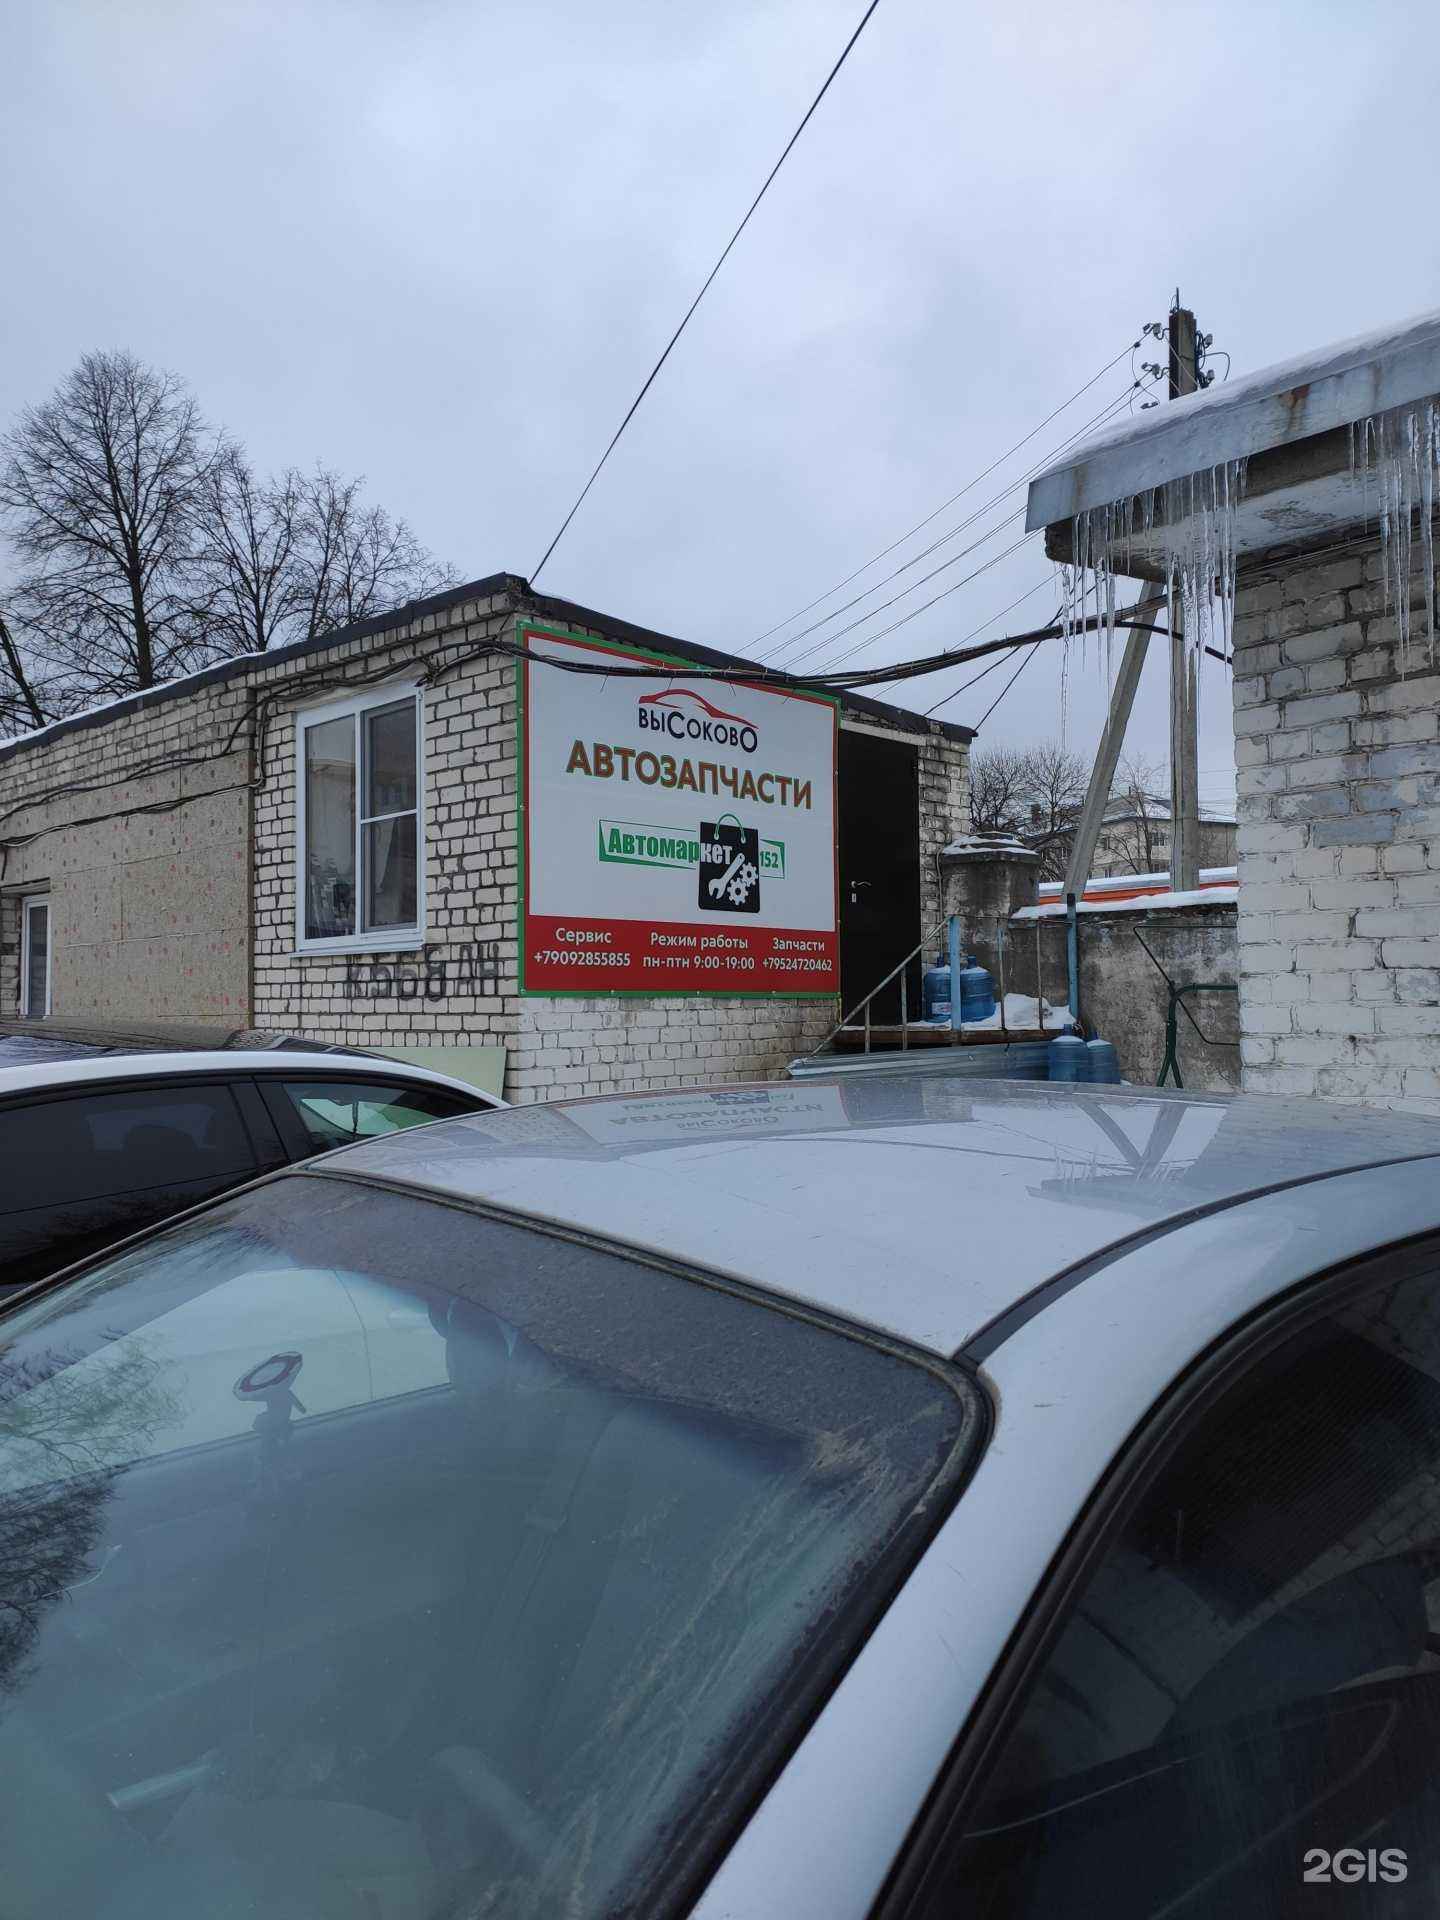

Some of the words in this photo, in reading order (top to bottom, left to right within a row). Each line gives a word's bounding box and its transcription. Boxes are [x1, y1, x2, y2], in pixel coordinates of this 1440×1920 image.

[566, 739, 812, 810] АВТОЗАПЧАСТИ
[608, 827, 733, 864] Автомаркет
[760, 850, 779, 869] 152
[555, 927, 612, 944] Сервис
[650, 931, 696, 948] Режим
[700, 934, 748, 950] работы
[772, 937, 825, 952] Запчасти
[533, 950, 631, 967] +79092855855
[642, 956, 690, 969] пн-птн
[693, 955, 755, 970] 9:00-19:00
[762, 959, 833, 972] +79524720462
